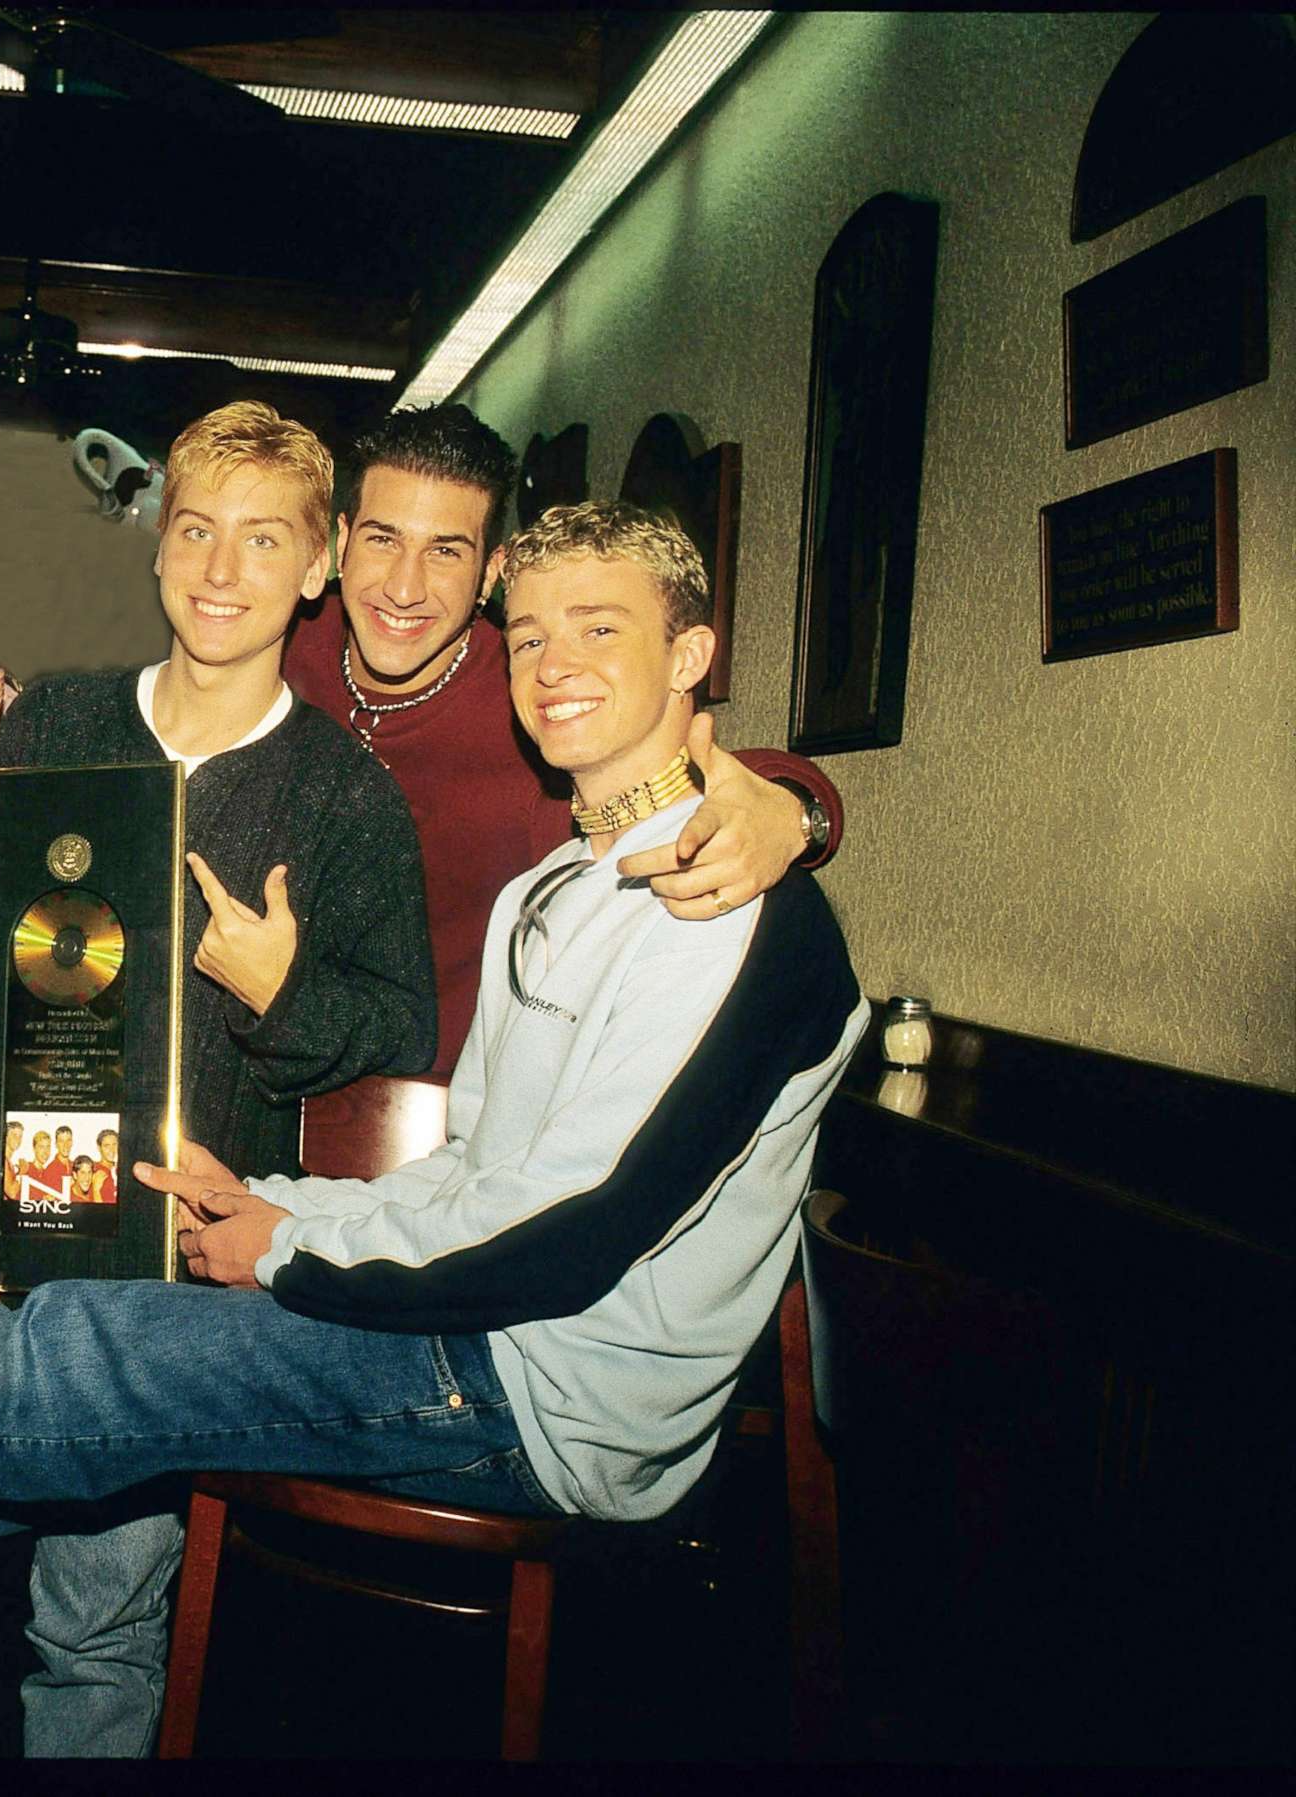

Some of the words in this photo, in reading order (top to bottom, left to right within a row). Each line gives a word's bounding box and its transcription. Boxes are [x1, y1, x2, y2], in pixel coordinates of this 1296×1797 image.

[1141, 497, 1171, 522] right
[1148, 520, 1210, 555] Anything
[1113, 565, 1138, 591] will
[1140, 562, 1155, 585] be
[1159, 549, 1203, 582] served
[1107, 605, 1136, 622] soon
[1138, 602, 1153, 617] as
[18, 1200, 72, 1215] SYNC
